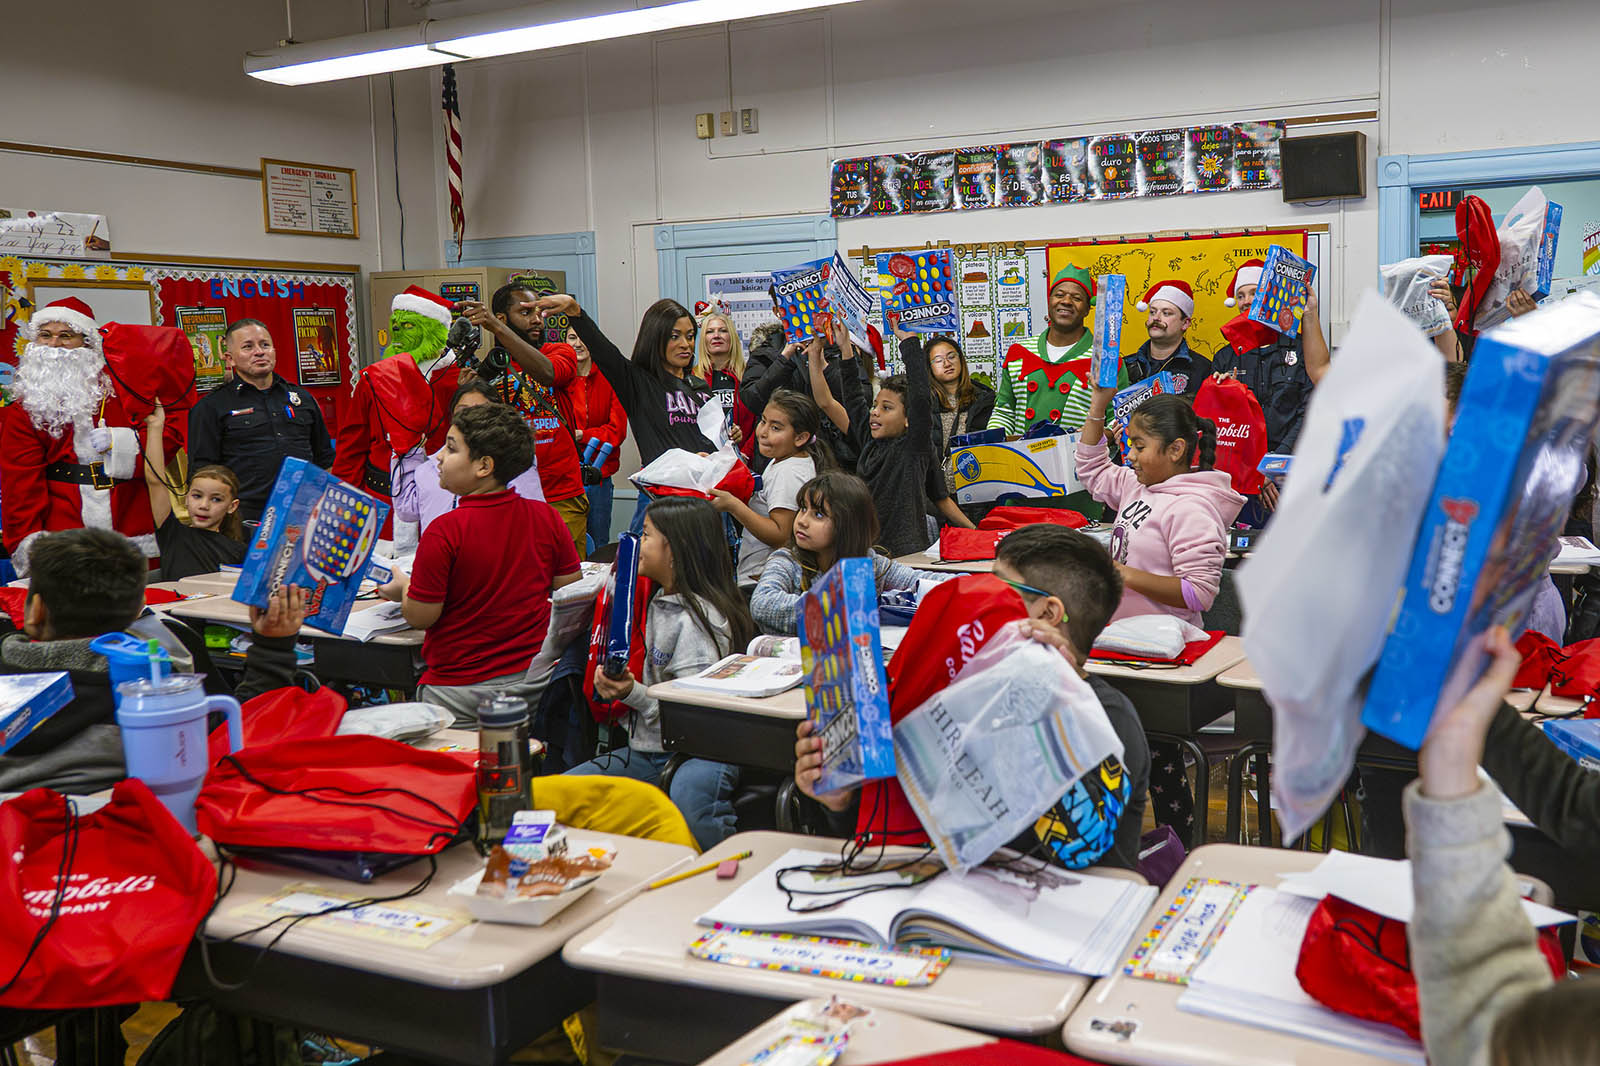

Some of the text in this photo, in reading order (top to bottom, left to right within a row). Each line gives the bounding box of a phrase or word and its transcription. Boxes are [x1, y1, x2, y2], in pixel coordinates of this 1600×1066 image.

[1193, 130, 1229, 143] NUNCA
[1101, 157, 1122, 166] duro
[280, 168, 336, 180] EMERGENCY SIGNALS
[846, 191, 858, 200] TUS
[1420, 191, 1452, 208] EXIT
[1233, 248, 1254, 256] THE
[779, 262, 830, 296] CONNECT 4
[1276, 263, 1305, 281] CONNECT
[210, 278, 304, 300] ENGLISH
[900, 304, 950, 322] CONNECT
[296, 316, 327, 326] HISTORICAL
[298, 327, 319, 338] FICTION
[1117, 389, 1153, 417] CONNECT
[534, 417, 560, 430] SPEAK
[1216, 424, 1250, 438] pbell's
[930, 701, 1010, 820] HIRLEAH
[29, 901, 110, 918] OMPANY
